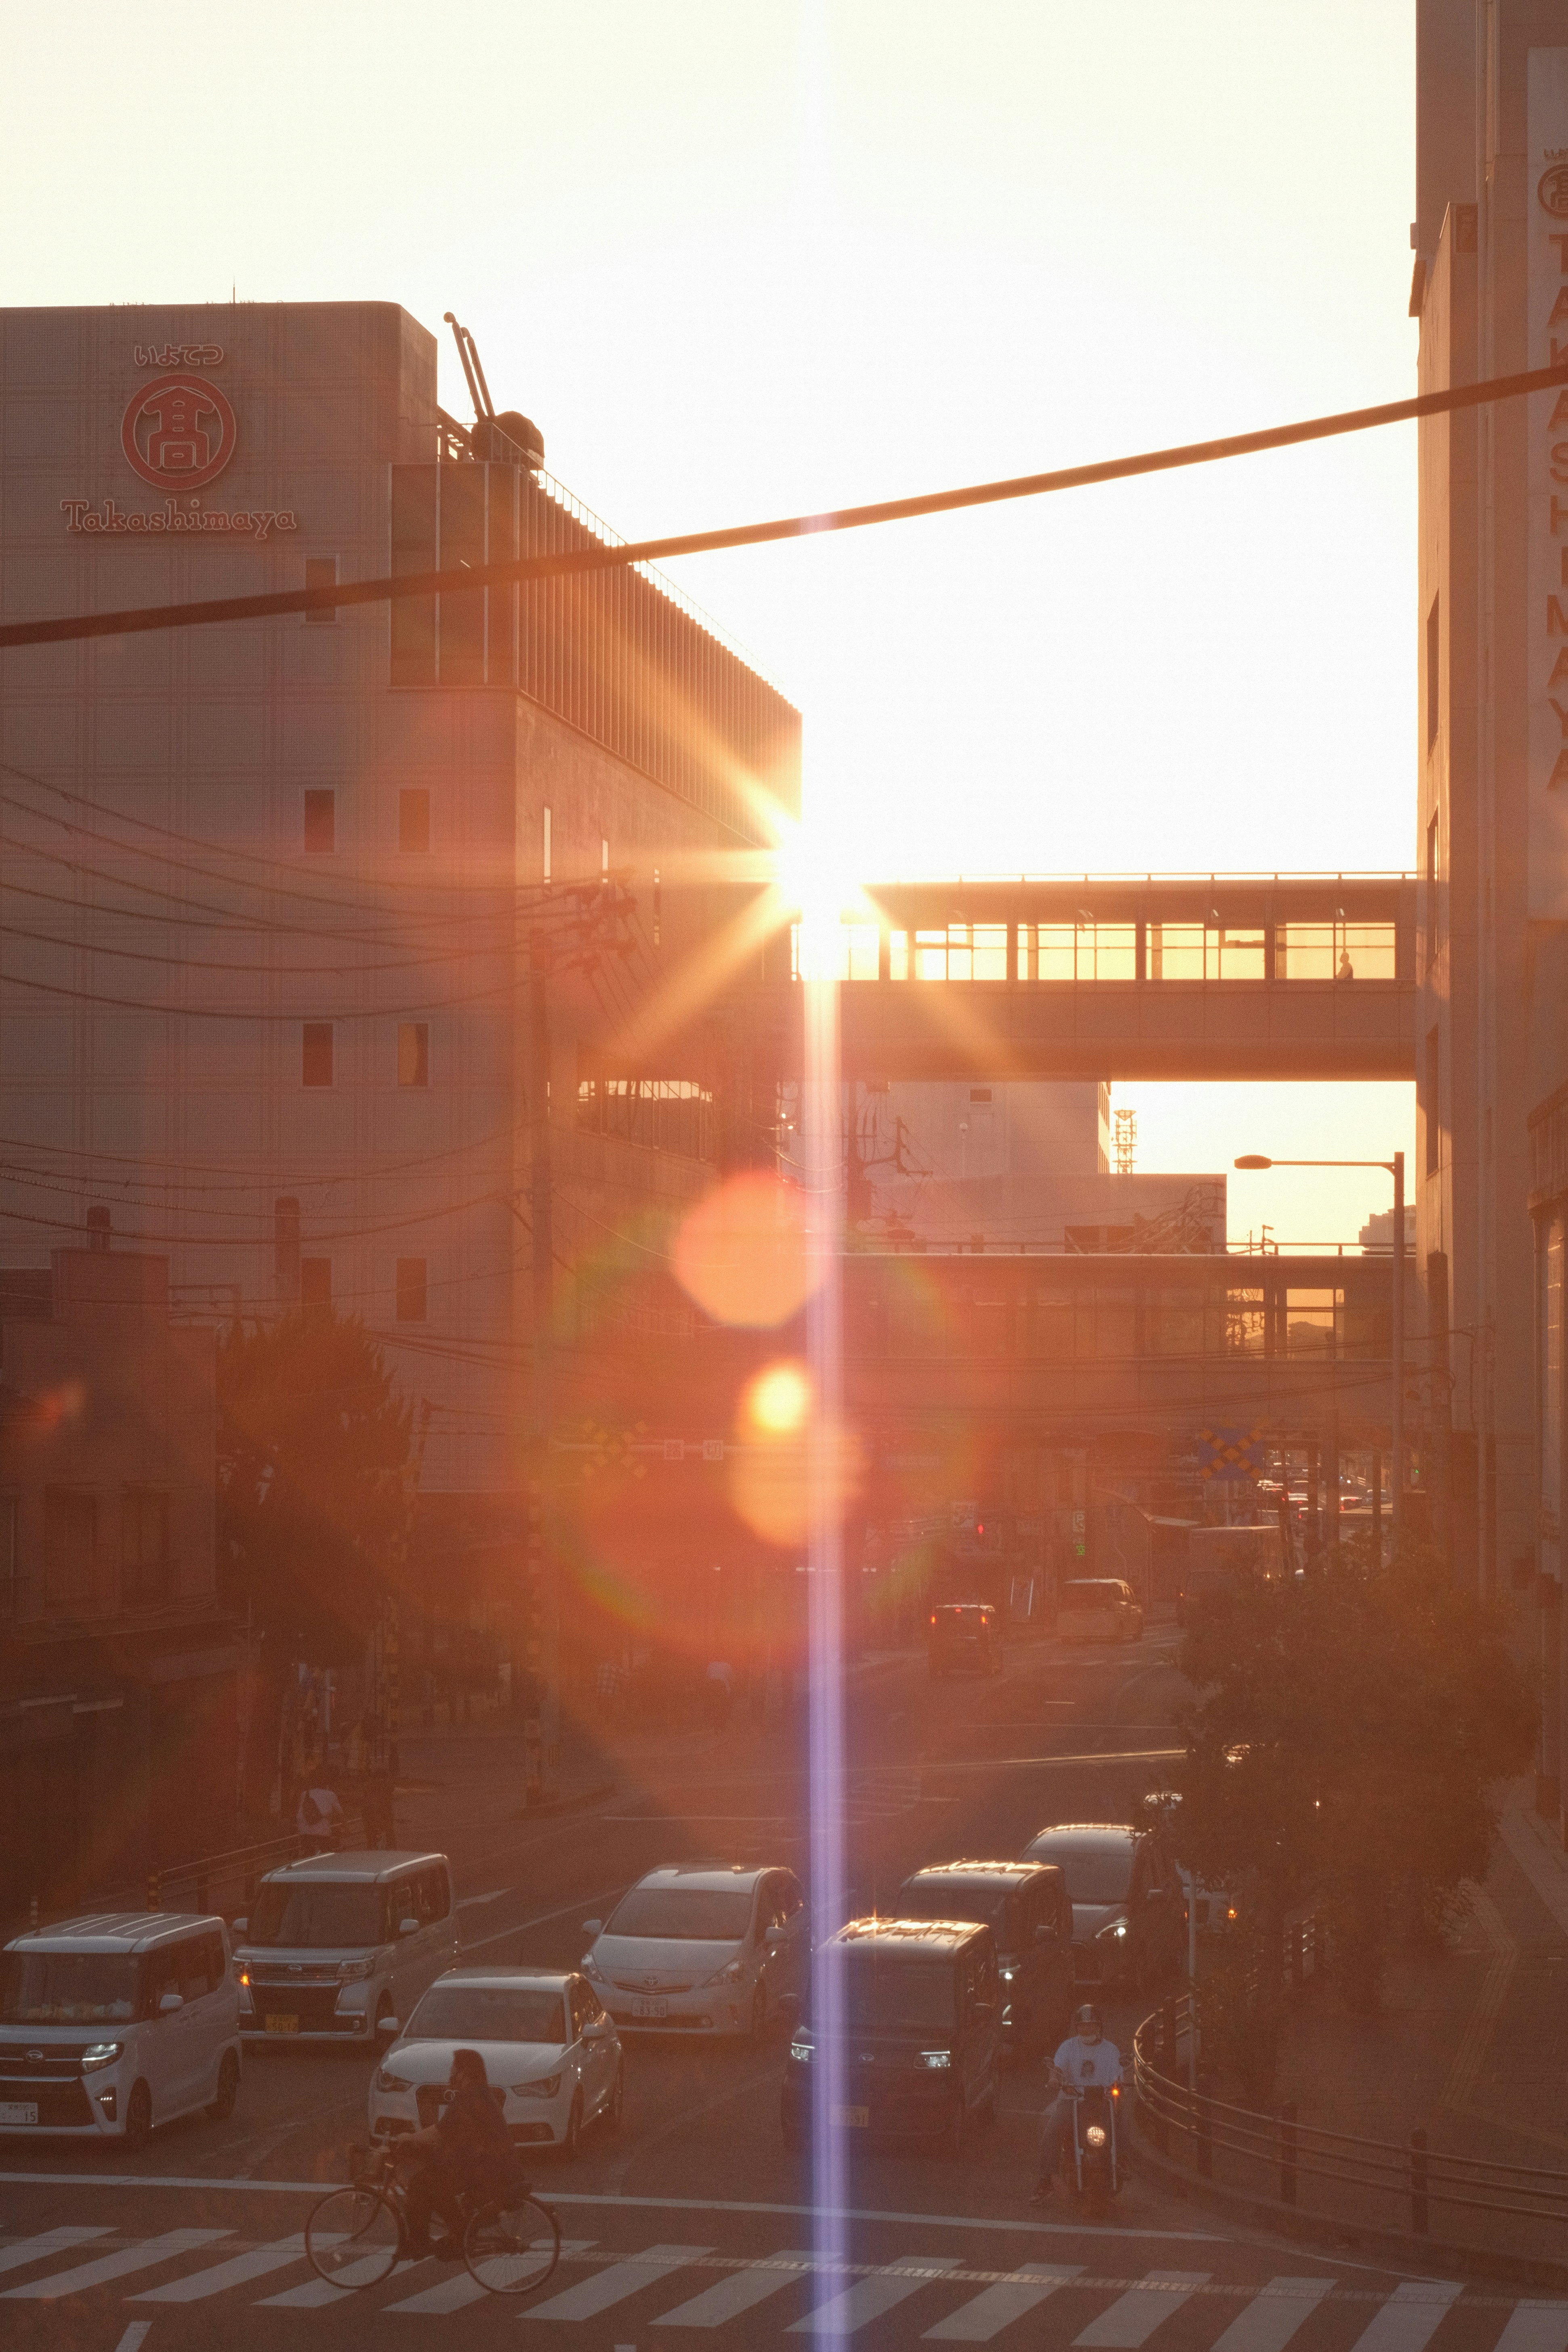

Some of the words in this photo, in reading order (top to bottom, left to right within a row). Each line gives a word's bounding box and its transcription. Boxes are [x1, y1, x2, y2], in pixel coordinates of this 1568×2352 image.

[134, 344, 224, 366] いよてつ
[60, 499, 297, 540] Takashimaya
